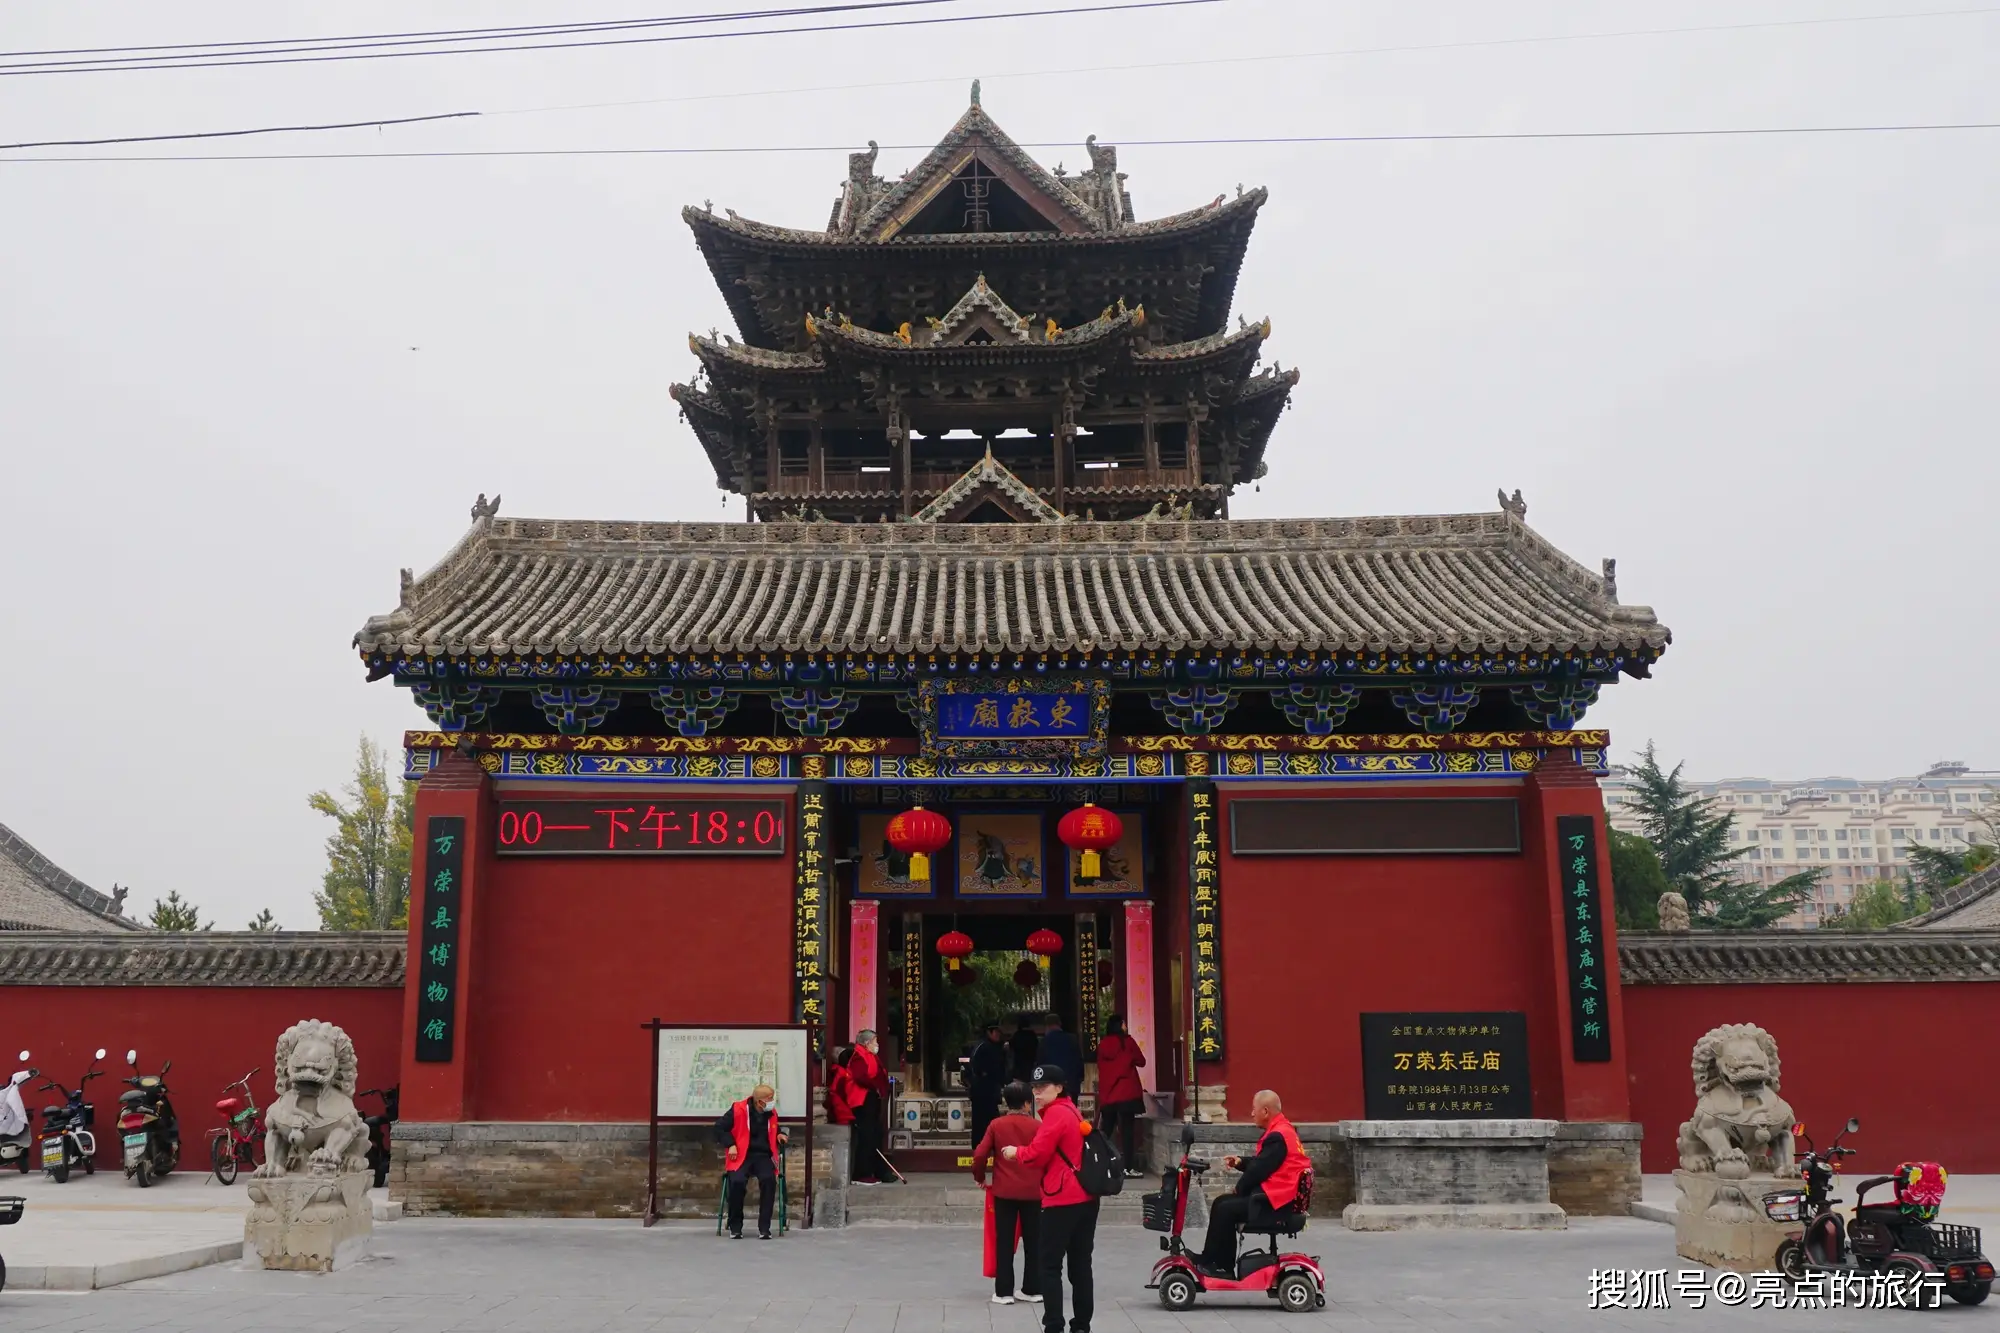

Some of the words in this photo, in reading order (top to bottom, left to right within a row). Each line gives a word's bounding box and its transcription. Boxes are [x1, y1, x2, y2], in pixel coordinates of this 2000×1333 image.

[500, 805, 781, 849] 00—下午18:0
[424, 835, 455, 1041] 万荣县博物馆
[1568, 834, 1601, 1039] 万荣县东岳庙文管所
[1391, 1025, 1501, 1036] 全国重点文物保护单位
[1393, 1050, 1501, 1071] 万荣东岳庙
[1387, 1084, 1511, 1095] 国务院1988年1月13日公布
[1406, 1101, 1494, 1112] 山西省人民政府立
